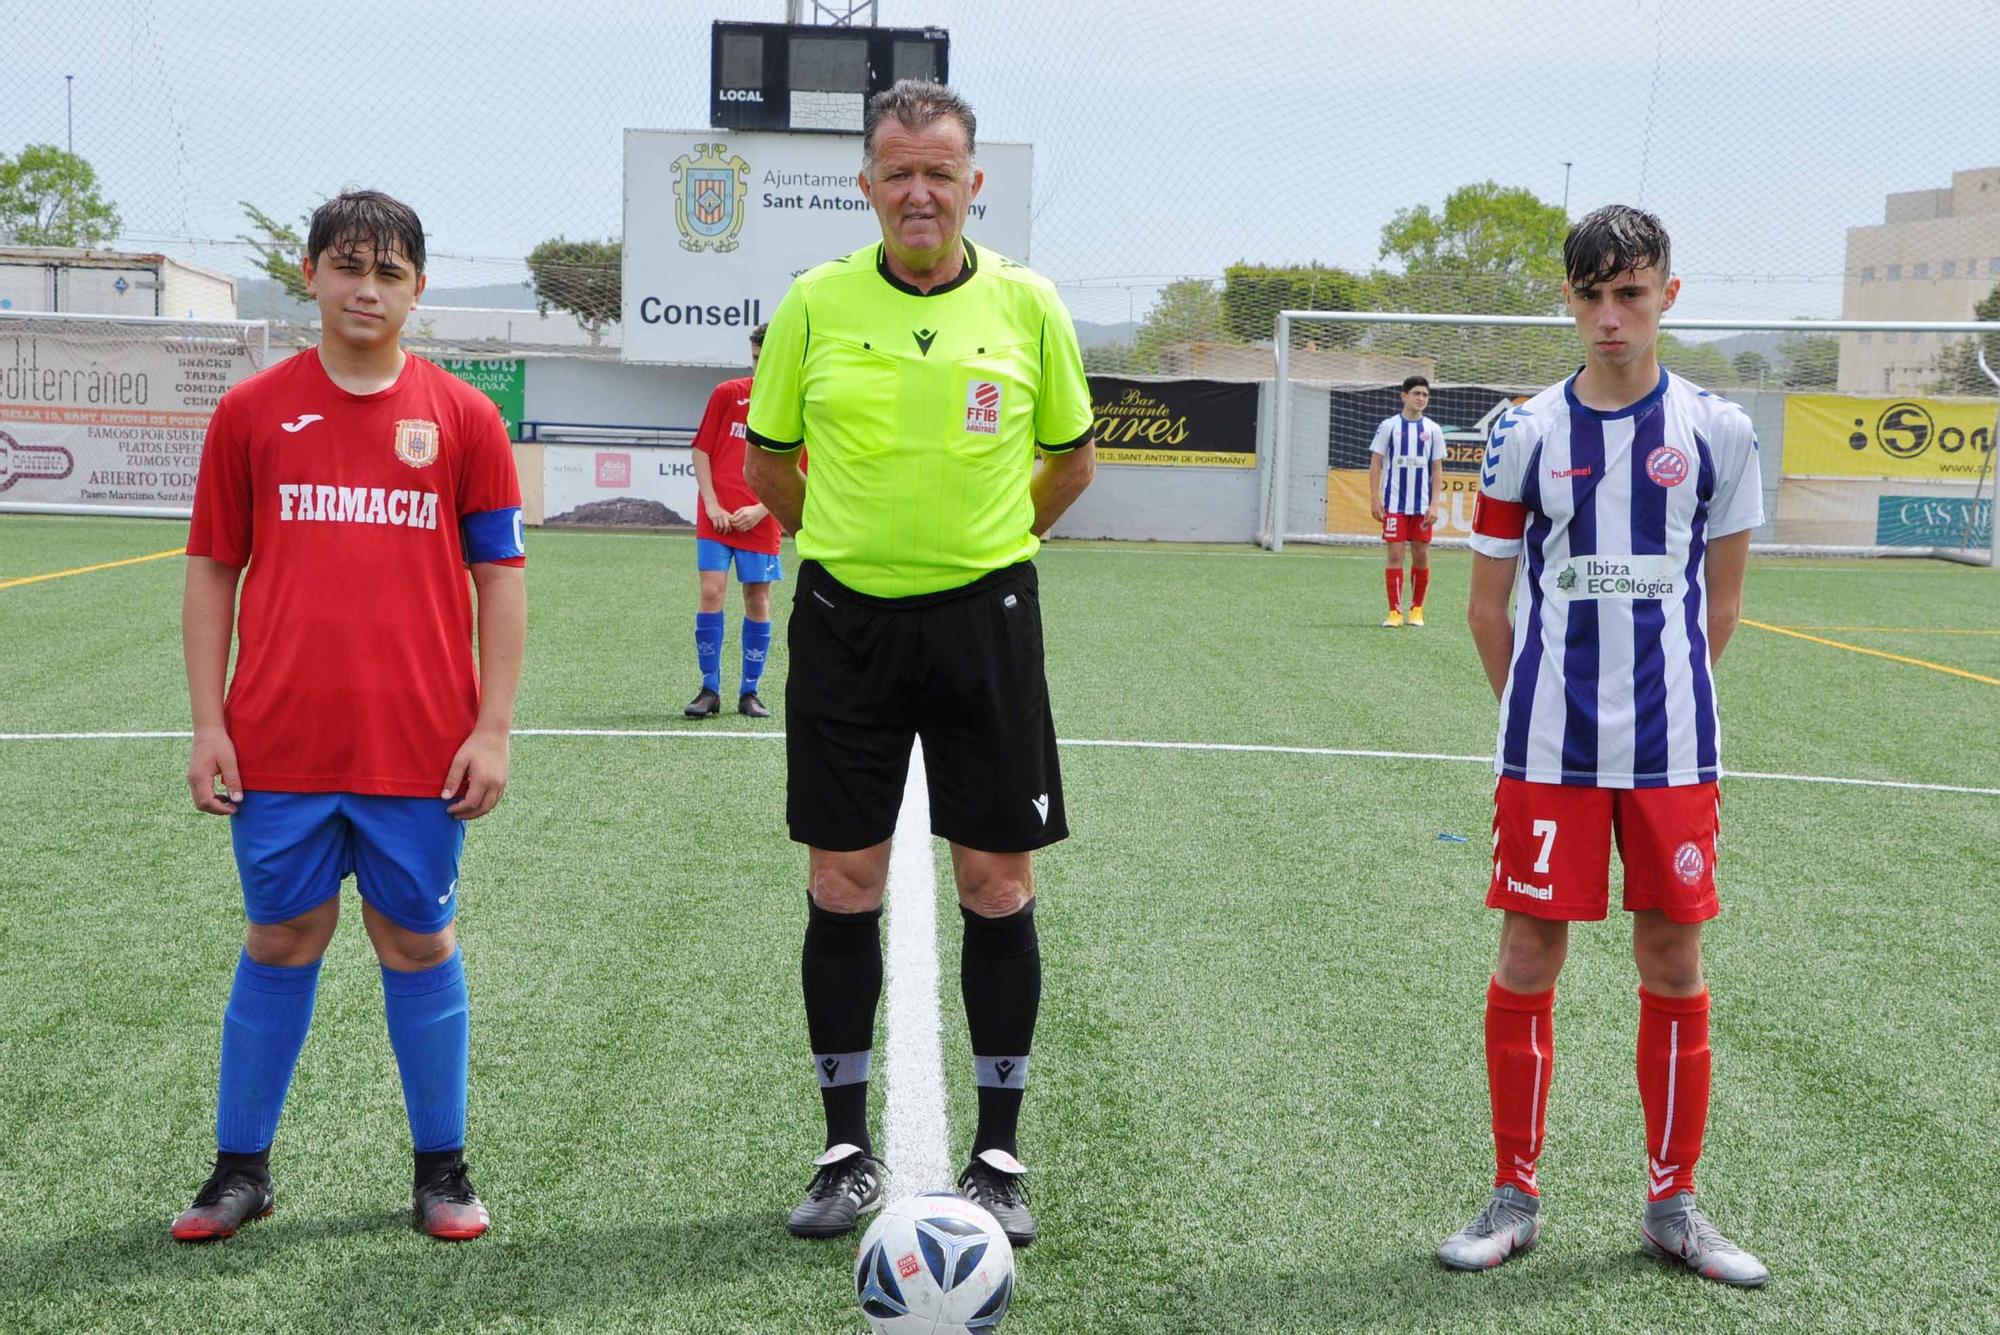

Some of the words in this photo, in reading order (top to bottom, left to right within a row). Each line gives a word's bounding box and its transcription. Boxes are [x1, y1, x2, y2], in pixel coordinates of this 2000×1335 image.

[719, 90, 764, 102] LOCAL
[763, 170, 858, 188] Ajuntamen
[763, 194, 804, 209] Sant
[640, 296, 760, 327] Consell
[5, 338, 148, 405] diterráneo
[184, 371, 226, 381] TAPAS
[183, 397, 218, 406] CENA
[1121, 389, 1155, 406] Bar
[967, 407, 998, 422] FFIB
[1092, 401, 1170, 416] estaurante
[88, 427, 139, 439] FAMOSO
[141, 429, 164, 440] POR
[167, 430, 189, 441] SUS
[1093, 416, 1189, 444] ares
[119, 442, 162, 453] PLATOS
[127, 455, 170, 466] ZUMOS
[1144, 455, 1179, 463] ANTONI
[1195, 456, 1247, 465] PORTMANY
[89, 471, 158, 487] ABIERTO
[1551, 466, 1592, 479] hummel
[157, 491, 180, 501] Sant
[279, 484, 438, 530] FARMACIA
[1386, 518, 1398, 531] 12
[1586, 561, 1630, 576] Ibiza
[1533, 820, 1557, 873] 7
[1507, 876, 1553, 900] hummel
